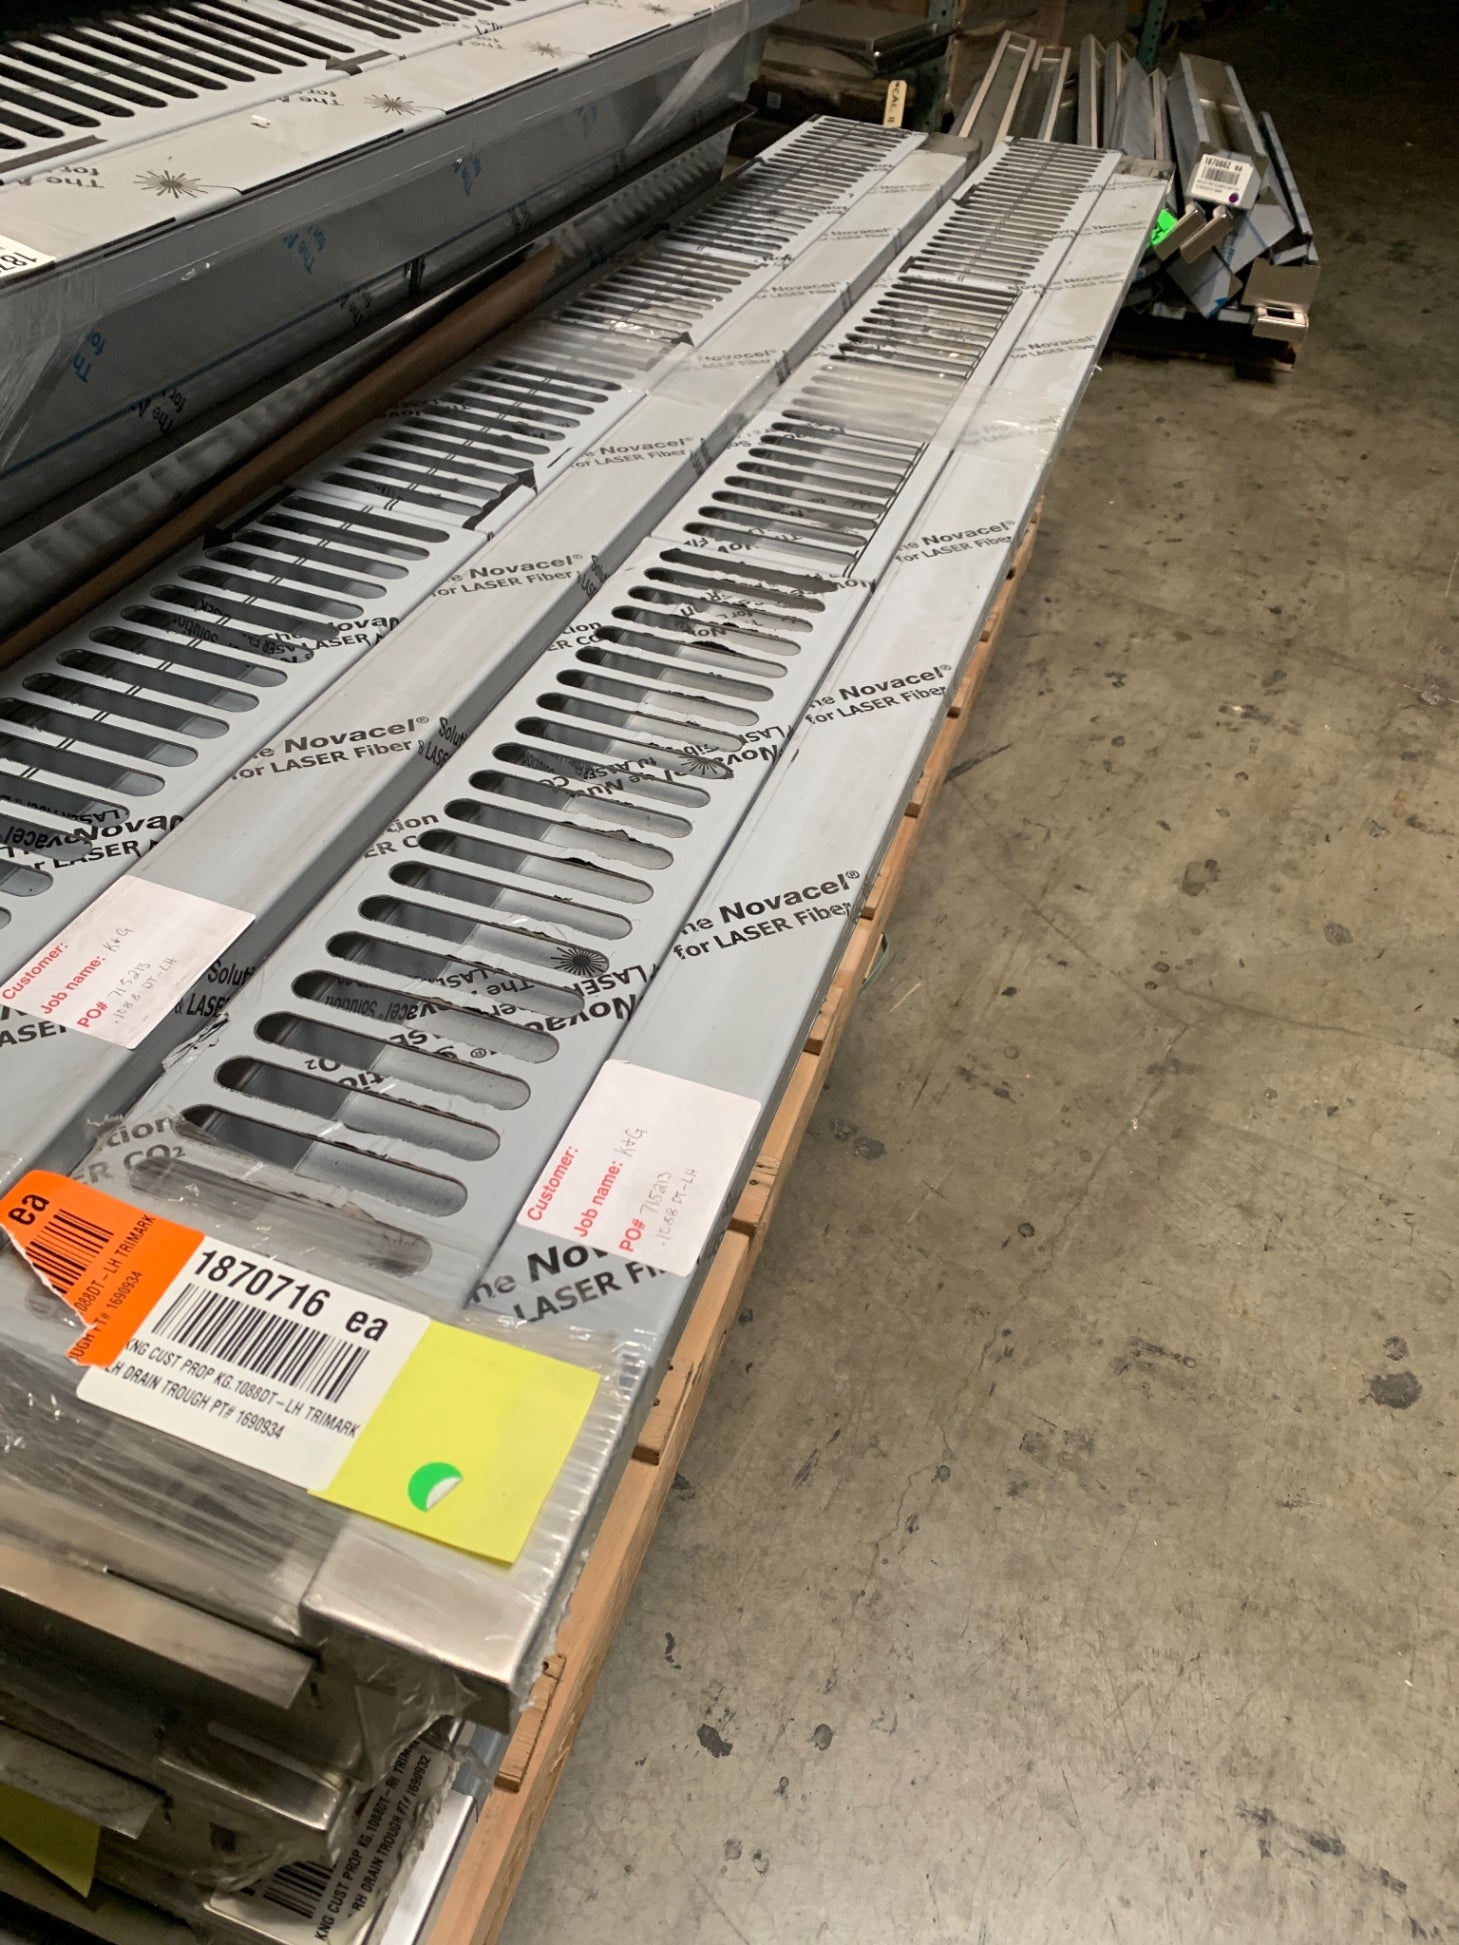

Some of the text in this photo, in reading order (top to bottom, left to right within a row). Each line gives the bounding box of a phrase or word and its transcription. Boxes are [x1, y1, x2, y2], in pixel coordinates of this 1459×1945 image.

[920, 541, 974, 559] LASER
[973, 535, 1013, 548] Fiber
[460, 576, 522, 594] LASER
[525, 569, 576, 585] Fiber
[805, 685, 948, 725] for LASER Fiber
[269, 749, 350, 774] LASER
[353, 740, 413, 759] Fiber
[673, 902, 852, 961] for LASER Fiber
[2, 942, 69, 1000] Customer:
[40, 990, 68, 1015] Job
[65, 955, 106, 991] name:
[76, 1000, 110, 1028] PO#
[8, 1193, 50, 1226] ea
[526, 1145, 579, 1222] Customer:
[573, 1207, 598, 1238] Job
[591, 1160, 624, 1206] name:
[114, 1214, 156, 1259] TRIMARK
[618, 1217, 647, 1253] PO#
[106, 1270, 143, 1310] 1690934
[193, 1249, 389, 1342] 1870716 ea
[122, 1363, 163, 1391] DRAIN
[160, 1375, 211, 1411] TROUGH
[210, 1398, 237, 1421] PT#
[235, 1408, 287, 1441] 1690934
[147, 1345, 187, 1370] CUST
[180, 1358, 215, 1382] PROP
[303, 1403, 363, 1440] TRIMARK
[360, 1855, 385, 1893] DRAIN
[406, 1753, 432, 1798] 1690932
[314, 1915, 335, 1941] KNG
[327, 1885, 350, 1918] CUST
[342, 1848, 364, 1882] PROP
